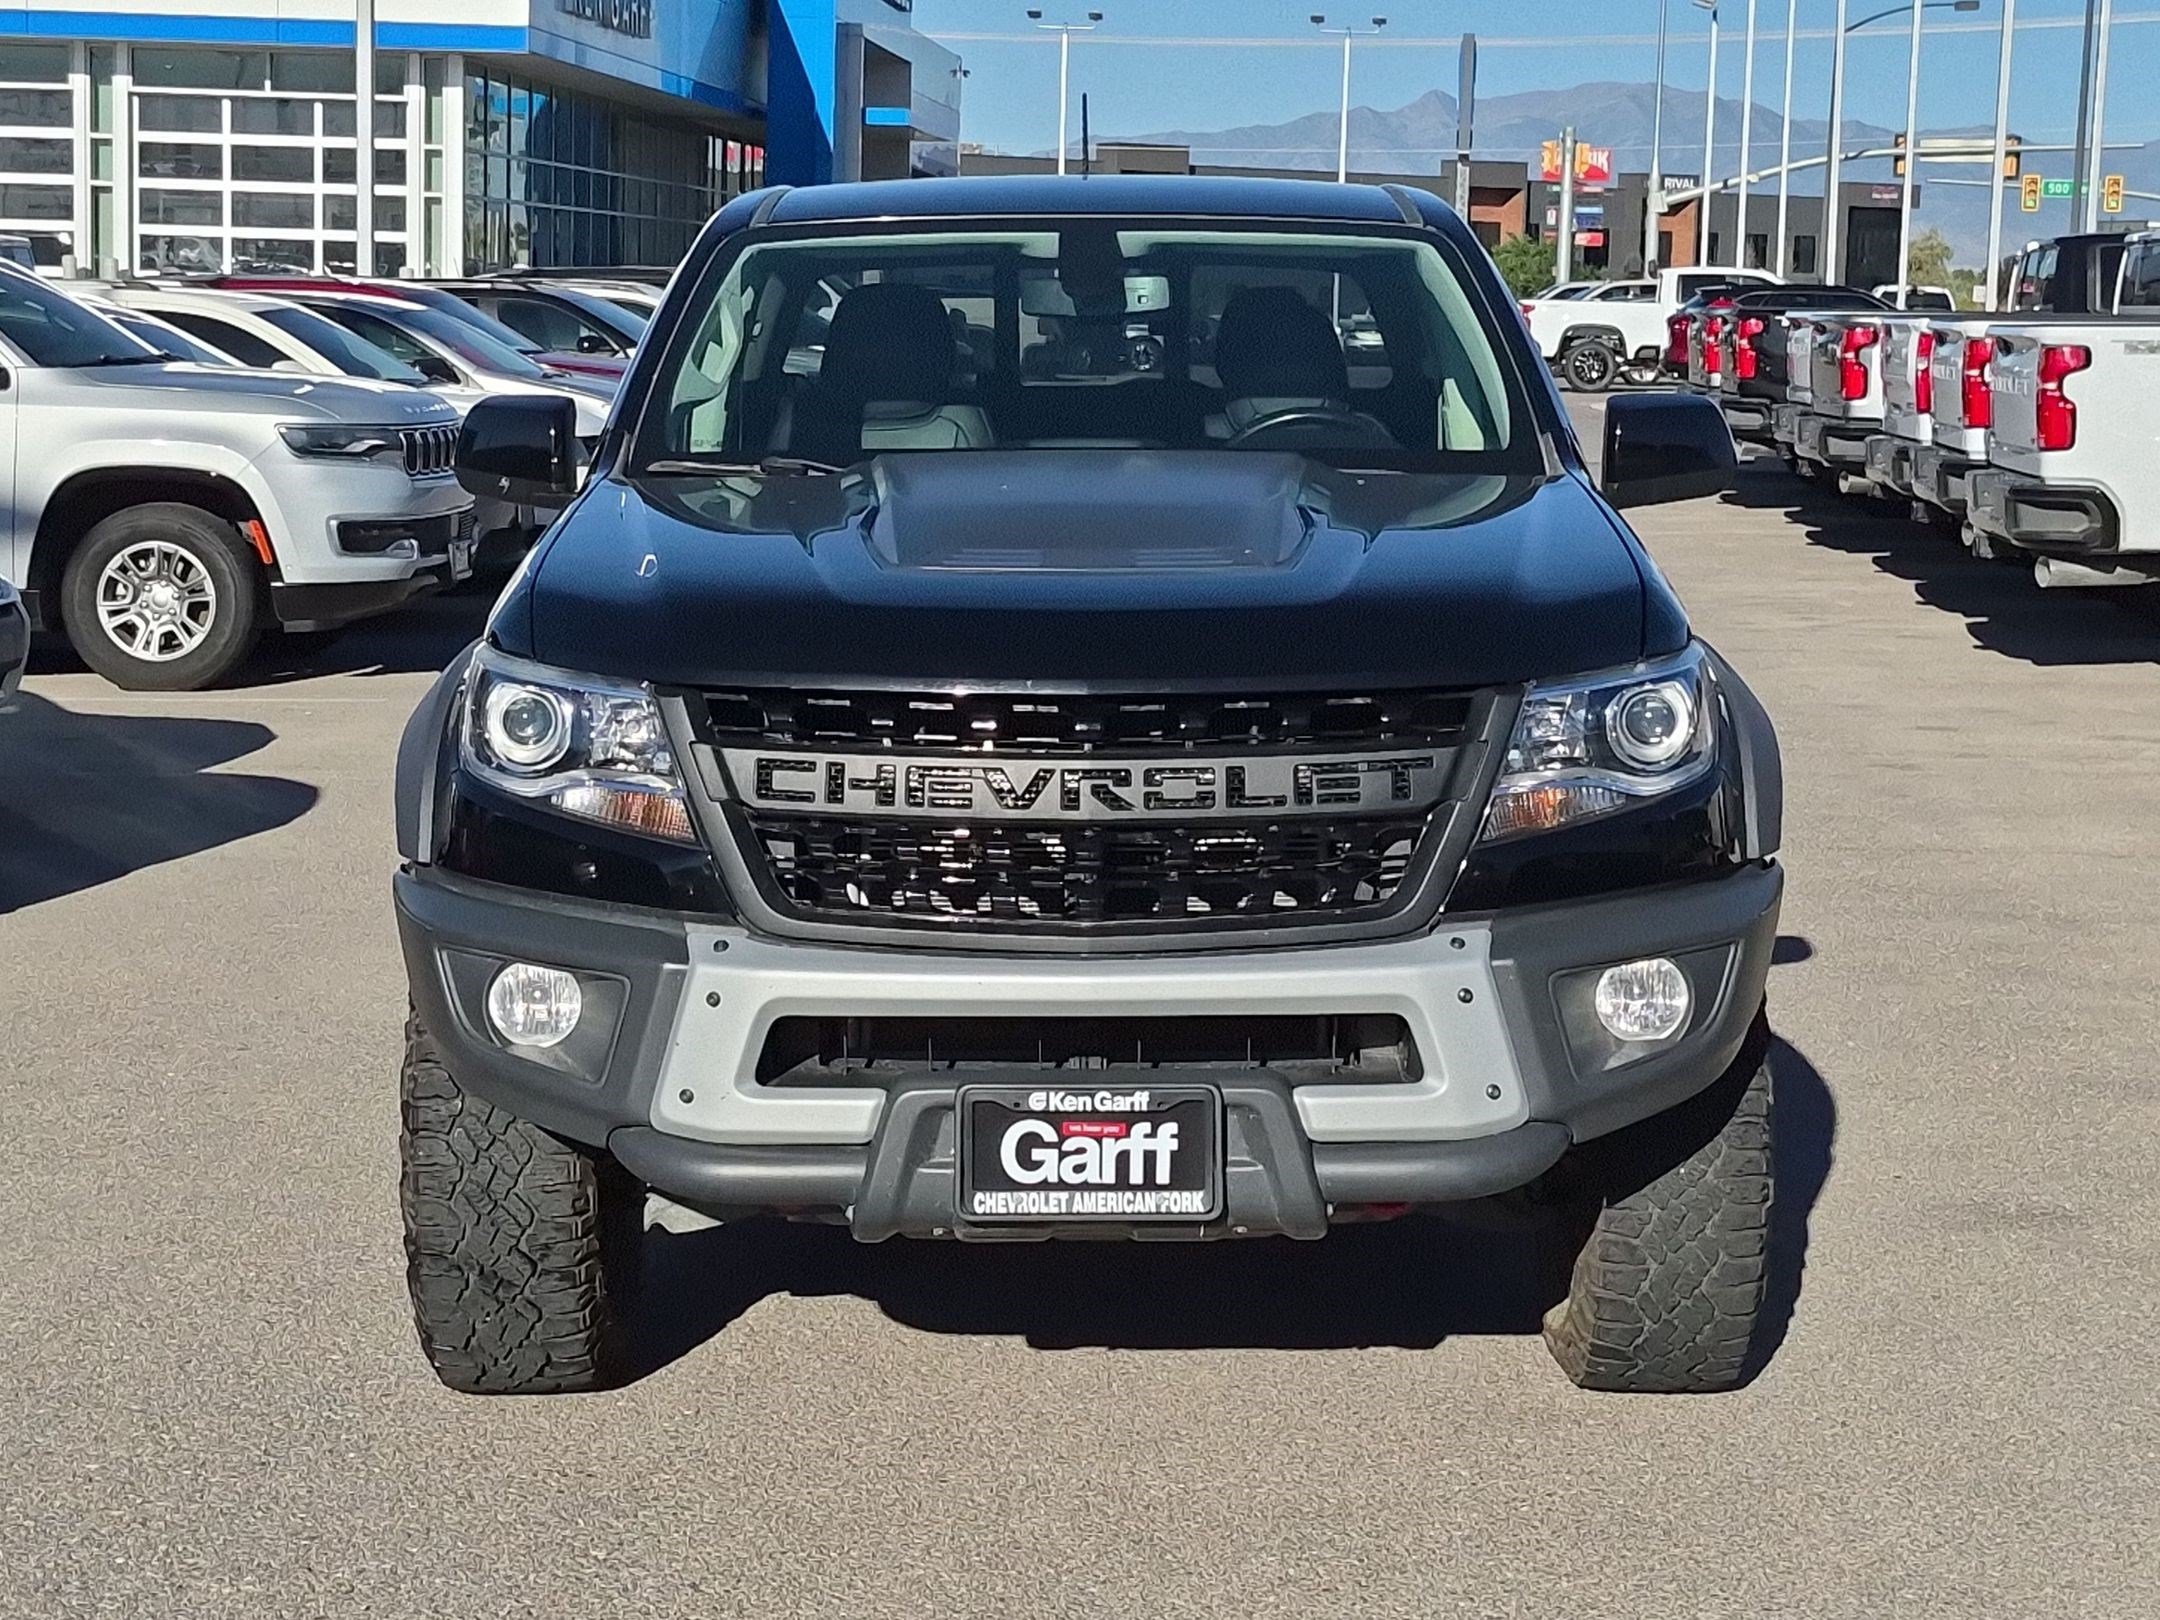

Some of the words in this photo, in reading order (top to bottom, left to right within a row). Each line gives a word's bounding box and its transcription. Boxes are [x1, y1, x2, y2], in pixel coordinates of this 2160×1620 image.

[1664, 177, 1696, 189] RIVAL
[2048, 183, 2070, 194] 500
[756, 756, 1434, 811] CHEVROLET
[1048, 1091, 1094, 1112] Ken
[1094, 1090, 1150, 1112] Garff
[1000, 1118, 1179, 1185] Garff
[973, 1191, 1068, 1214] CHEVROLET
[1072, 1191, 1156, 1214] AMERICAN
[1158, 1191, 1205, 1214] FORK
